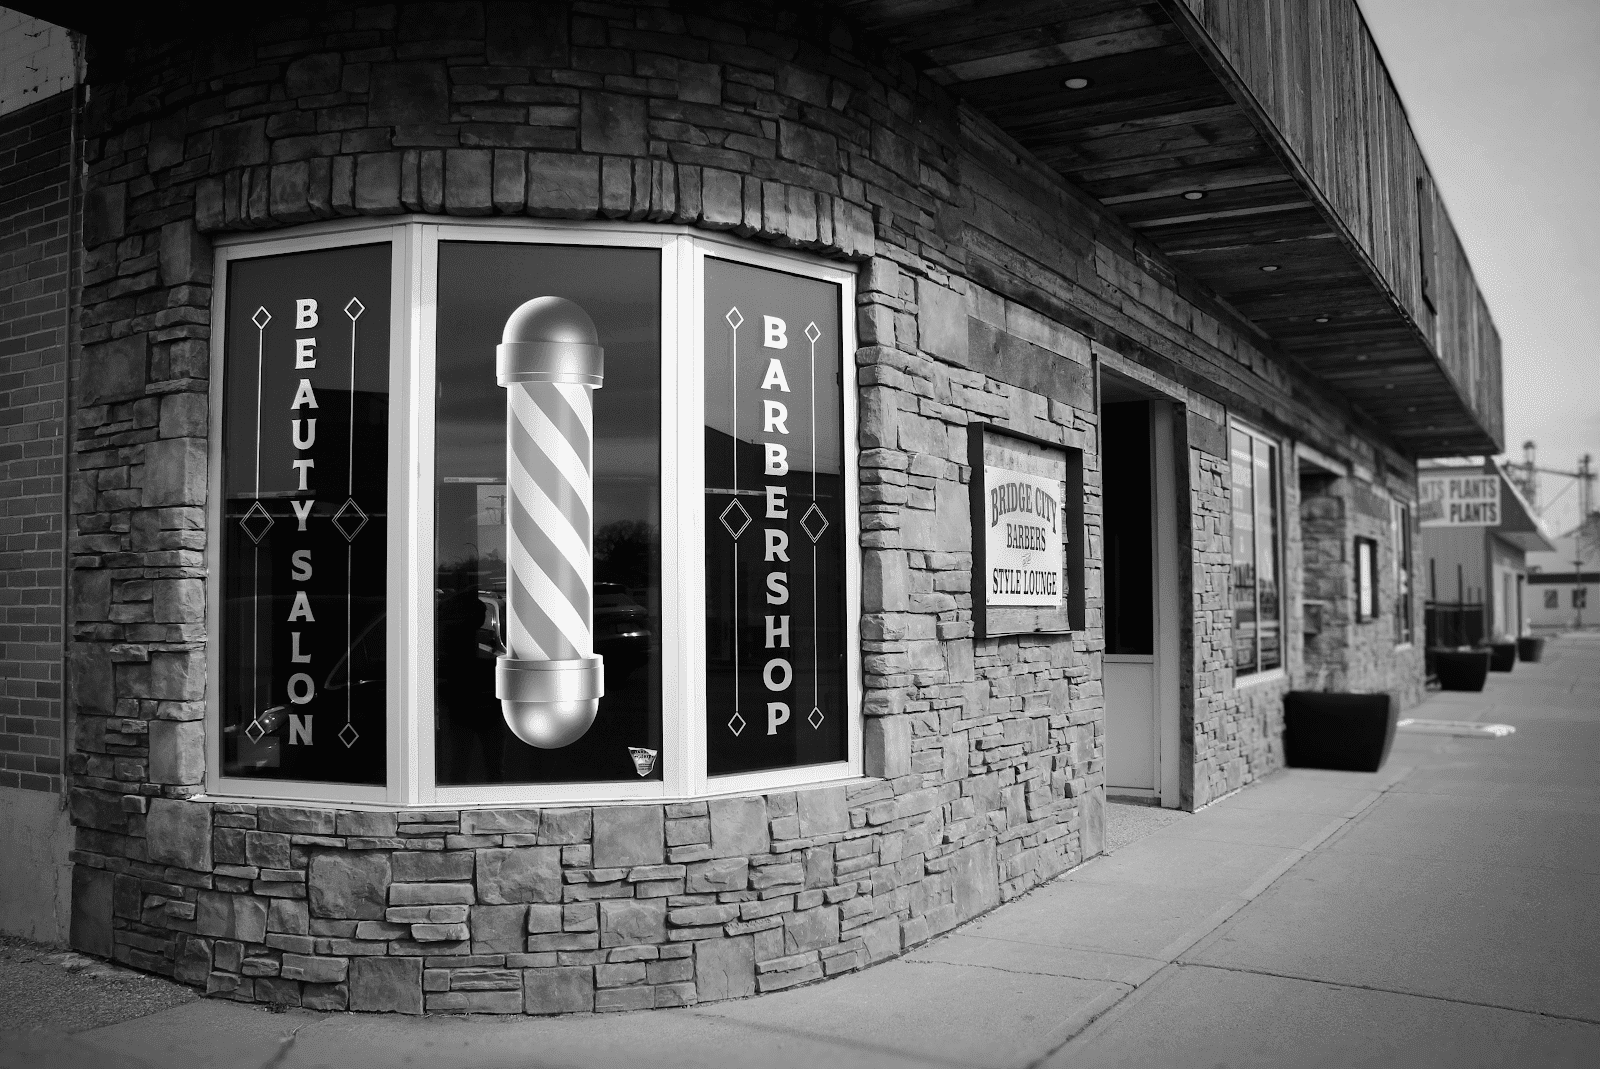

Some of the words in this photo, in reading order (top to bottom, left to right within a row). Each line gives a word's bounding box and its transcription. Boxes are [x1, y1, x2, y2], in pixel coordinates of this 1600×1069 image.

[290, 298, 320, 532] BEAUTY
[990, 482, 1033, 528] BRIDGE
[1035, 487, 1057, 534] CITY
[1450, 479, 1496, 499] PLANTS
[760, 315, 793, 736] BARBERSHOP
[1450, 503, 1496, 523] PLANTS
[1006, 523, 1046, 552] BARBERS
[992, 568, 1021, 595] STYLE
[1023, 569, 1057, 596] LOUNGE
[287, 549, 316, 746] SALON
